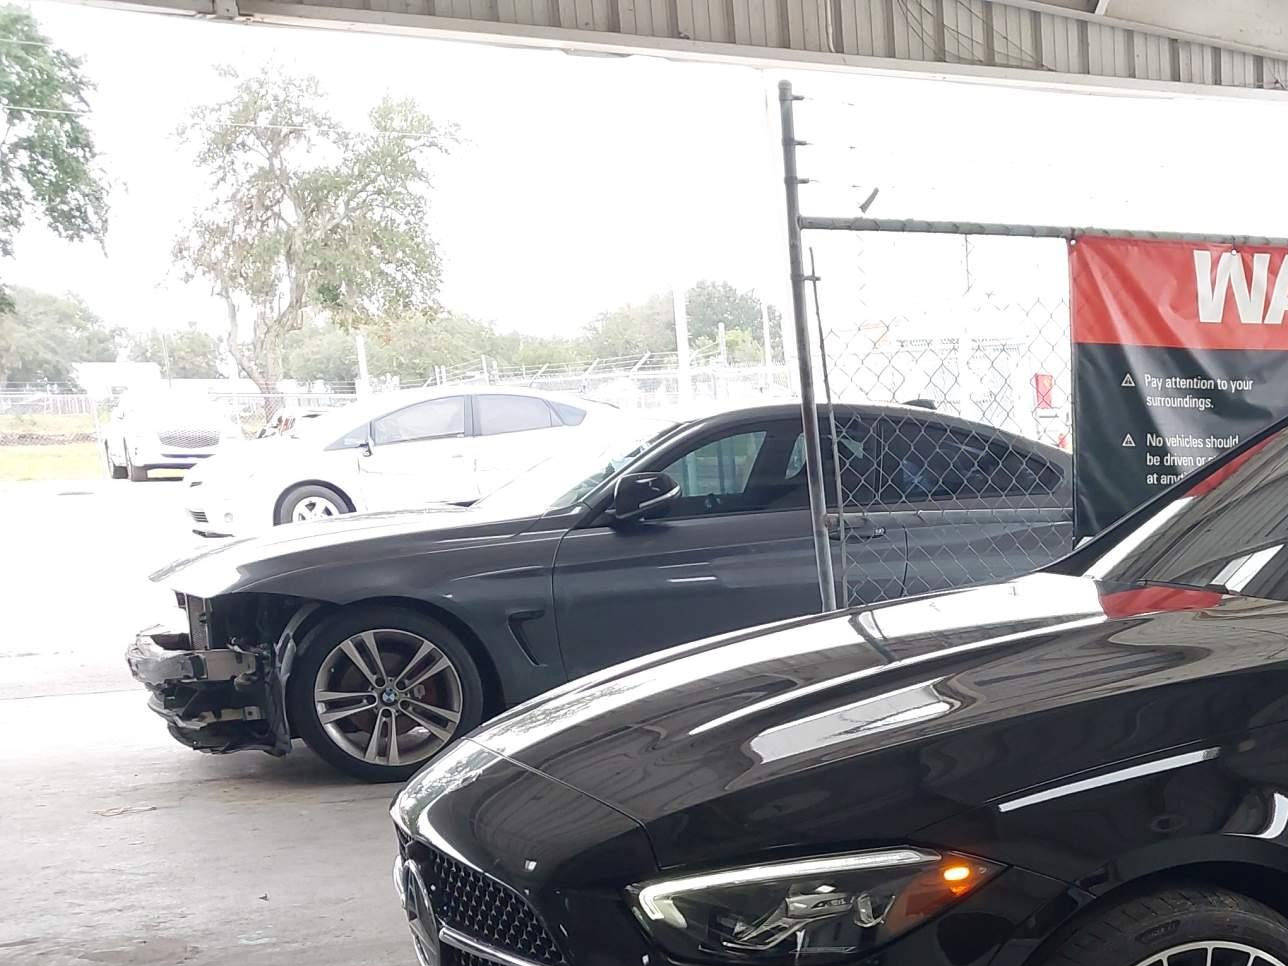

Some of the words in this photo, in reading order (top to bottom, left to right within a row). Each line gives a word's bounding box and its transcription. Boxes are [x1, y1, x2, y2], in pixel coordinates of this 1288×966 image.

[1144, 374, 1163, 391] Pay
[1165, 376, 1215, 390] attention
[1217, 378, 1228, 391] to
[1230, 379, 1254, 393] your
[1146, 395, 1214, 411] surroundings.
[1146, 433, 1163, 447] No
[1165, 435, 1203, 448] vehicles
[1205, 435, 1239, 448] should
[1146, 453, 1161, 466] be
[1163, 453, 1194, 466] driven
[1196, 456, 1206, 467] or
[1146, 472, 1158, 485] at
